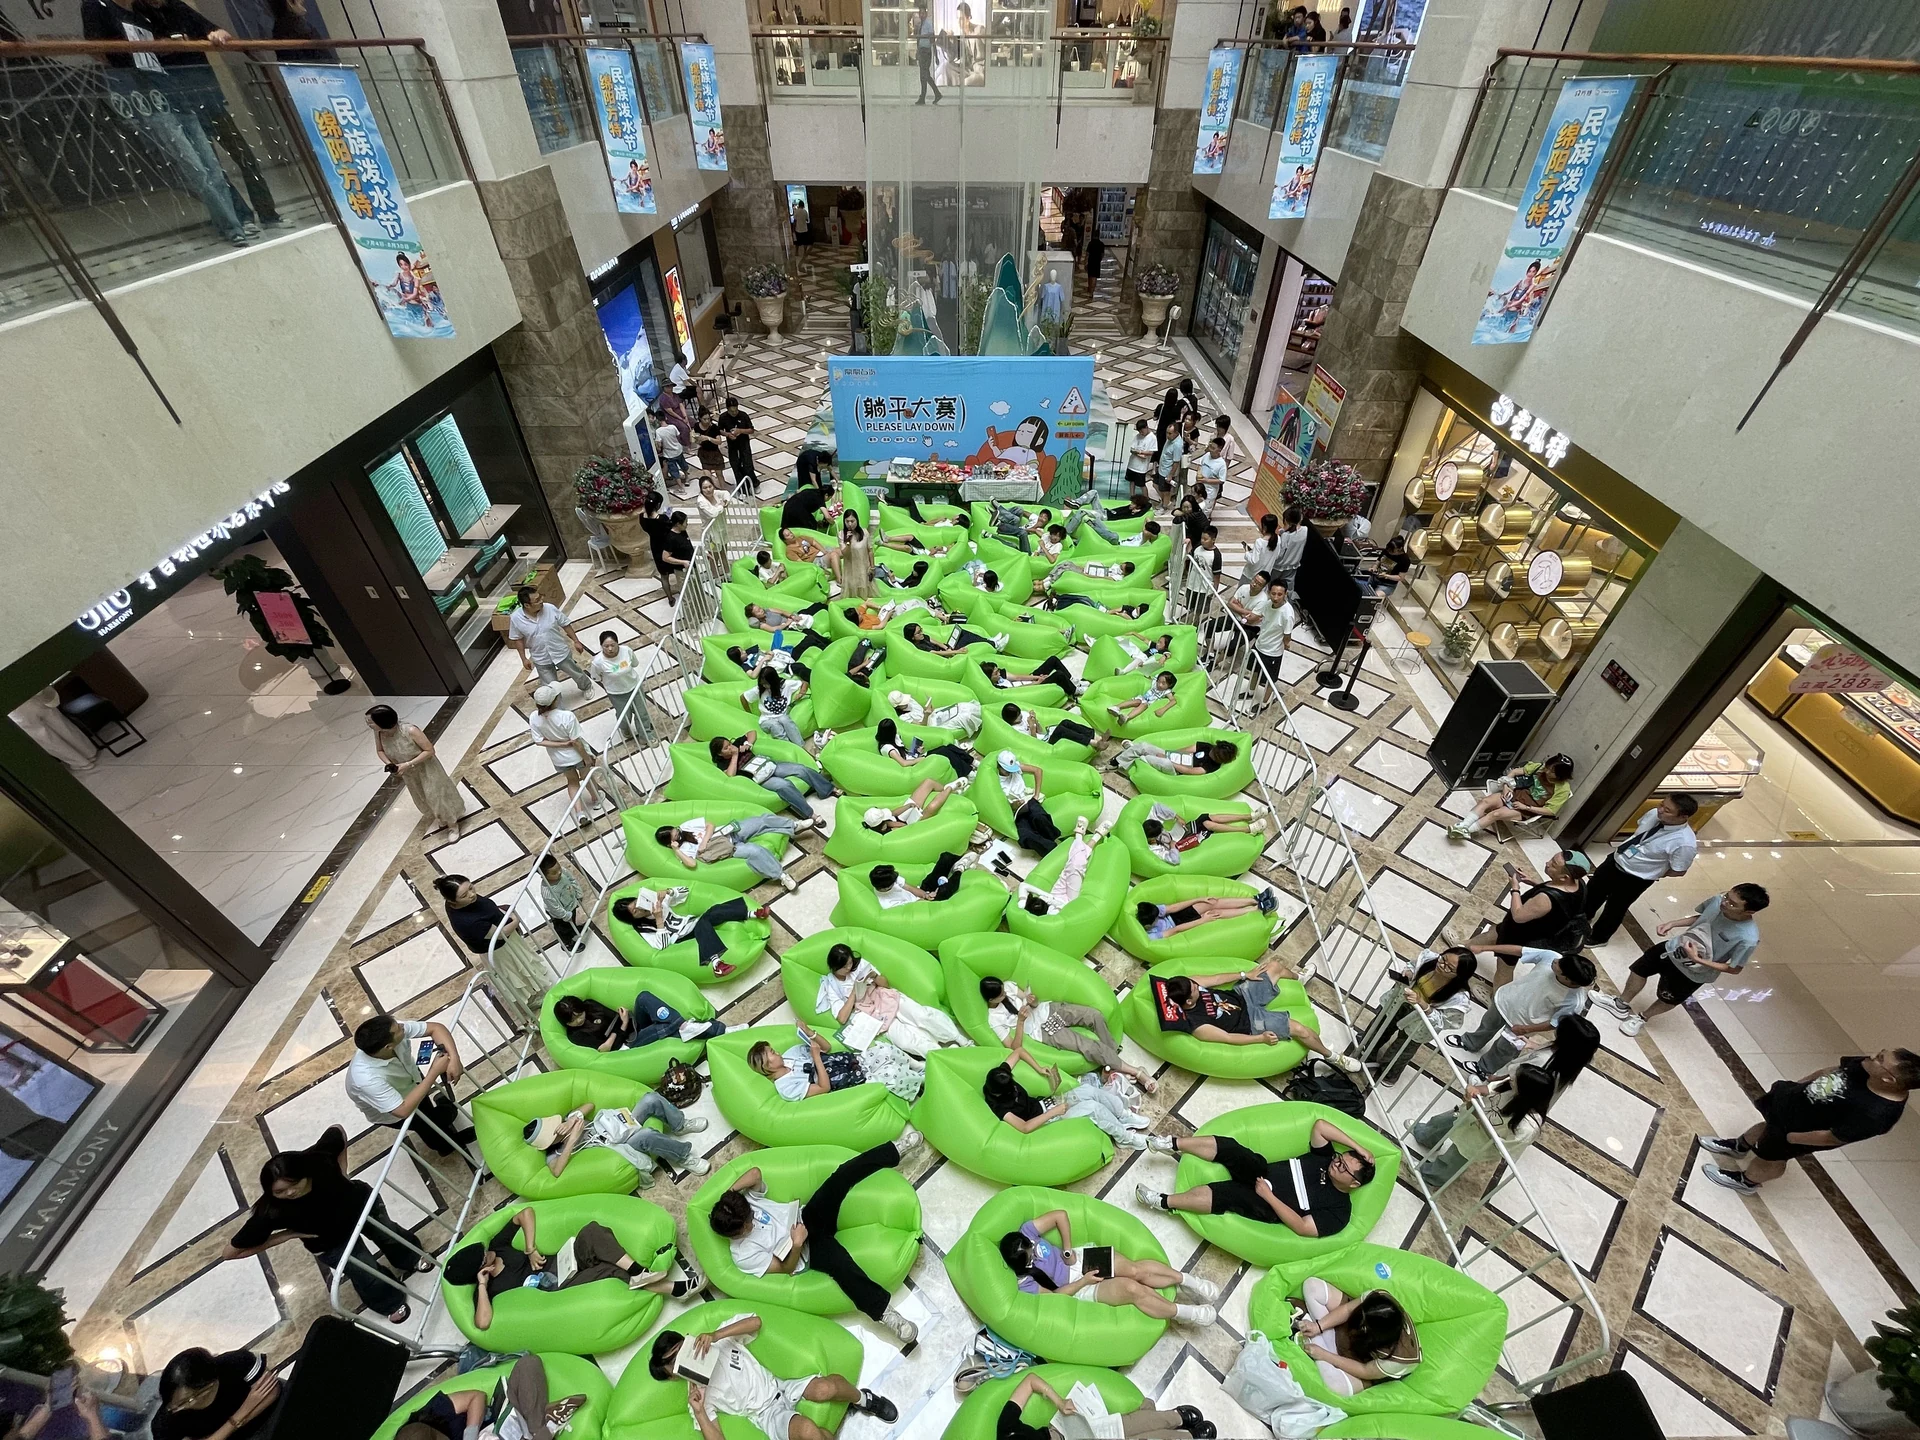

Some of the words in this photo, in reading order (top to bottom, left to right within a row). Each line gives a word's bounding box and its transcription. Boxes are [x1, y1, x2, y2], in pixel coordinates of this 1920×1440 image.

[600, 73, 622, 138] 绵阳方特
[610, 66, 637, 151] 民族泼水节
[690, 64, 705, 112] 绵阳方特
[699, 58, 715, 121] 民族泼水节
[1207, 68, 1223, 117] 绵阳方特
[1215, 61, 1233, 125] 民族泼水节
[1290, 81, 1313, 145] 绵阳方特
[1300, 72, 1326, 156] 民族泼水节
[313, 108, 374, 219] 绵阳方特
[330, 96, 403, 239] 民族泼水节
[1524, 121, 1580, 229] 绵阳方特
[1540, 106, 1608, 246] 民族泼水节
[866, 422, 902, 431] PLEASE
[905, 422, 922, 431] LAY
[924, 422, 955, 431] DOWN
[98, 608, 134, 637] HARMONY
[18, 1119, 119, 1240] HARMONY
